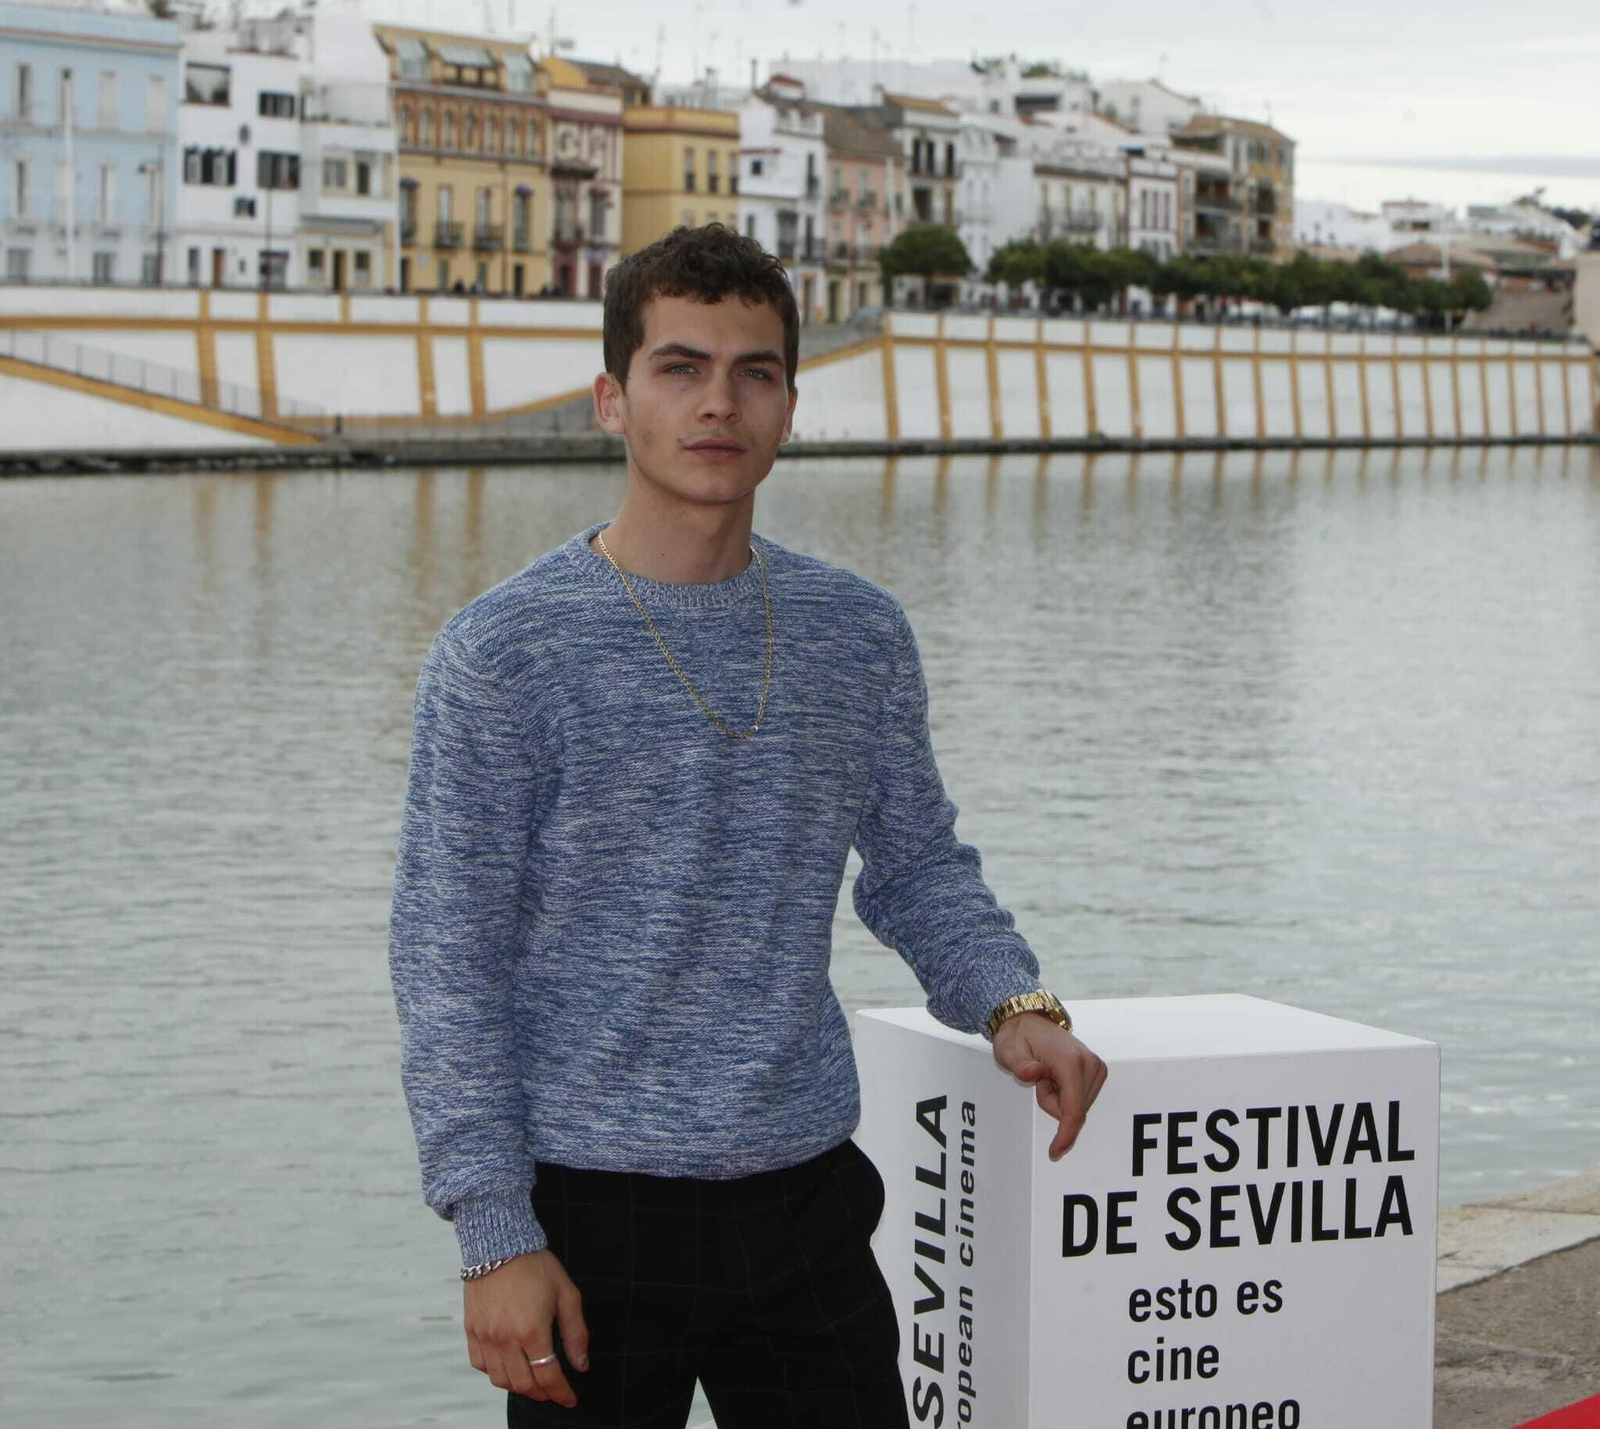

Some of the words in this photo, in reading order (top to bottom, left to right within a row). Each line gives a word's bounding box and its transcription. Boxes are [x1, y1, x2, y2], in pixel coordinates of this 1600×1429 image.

[1131, 1100, 1415, 1177] FESTIVAL
[955, 1100, 976, 1268] cinema
[1061, 1190, 1138, 1258] DE
[1164, 1174, 1414, 1251] SEVILLA
[913, 1094, 947, 1429] SEVILLA
[1128, 1278, 1218, 1323] esto
[1236, 1279, 1284, 1316] es
[957, 1285, 977, 1429] opean
[1127, 1336, 1220, 1385] cine
